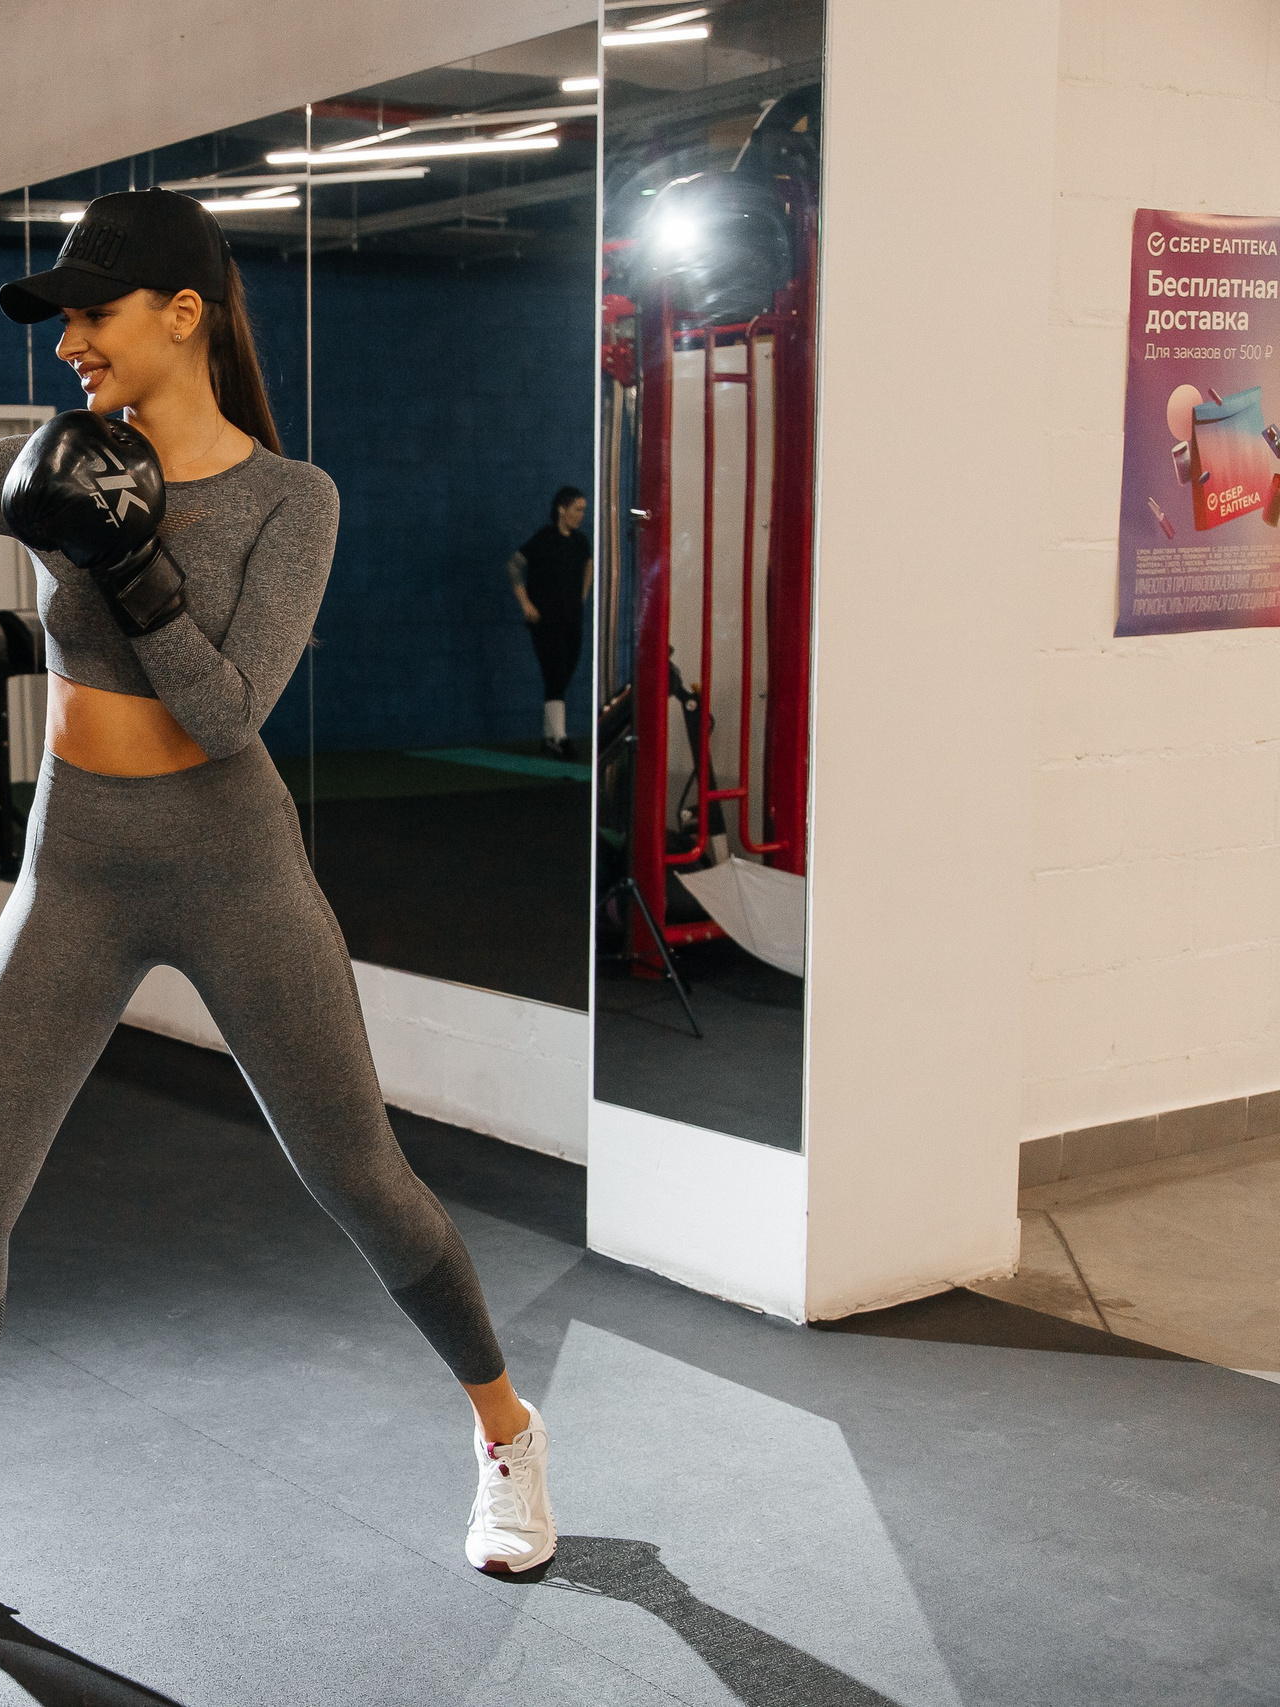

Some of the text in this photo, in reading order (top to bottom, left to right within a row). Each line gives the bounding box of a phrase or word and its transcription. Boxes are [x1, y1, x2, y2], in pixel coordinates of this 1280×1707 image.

[1169, 236, 1277, 255] СБЕР ЕАПТЕКА
[1148, 269, 1278, 299] Бесплатная
[1145, 309, 1249, 334] доставка
[1144, 343, 1170, 360] Для
[1173, 346, 1221, 360] заказов
[1223, 347, 1237, 360] от
[1239, 344, 1261, 360] 500
[1219, 485, 1243, 503] СБЕР
[1220, 491, 1261, 517] ЕАПТЕКА
